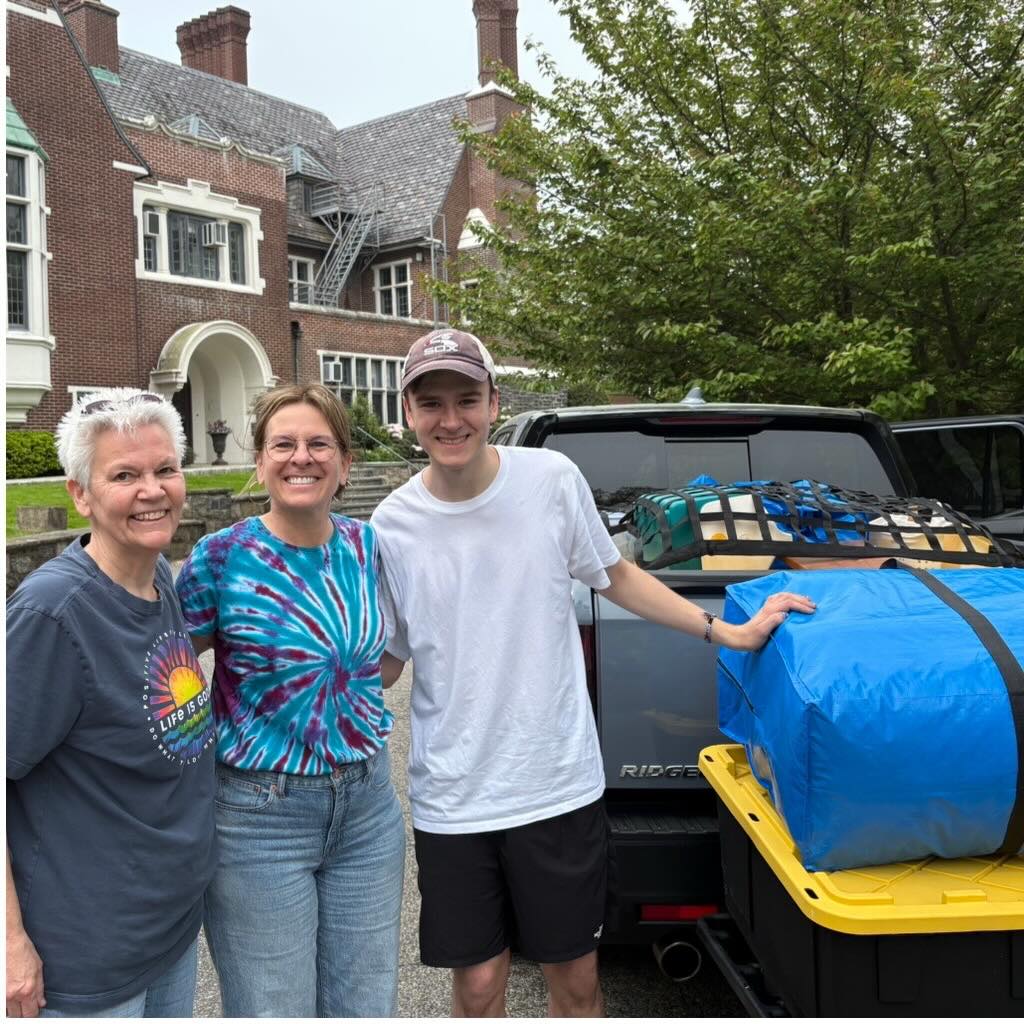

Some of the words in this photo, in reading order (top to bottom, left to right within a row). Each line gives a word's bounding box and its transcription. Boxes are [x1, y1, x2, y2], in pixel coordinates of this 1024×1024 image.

[424, 345, 458, 356] SOX
[160, 709, 184, 732] LIFE
[187, 701, 196, 716] IS
[620, 764, 699, 778] RIDGE
